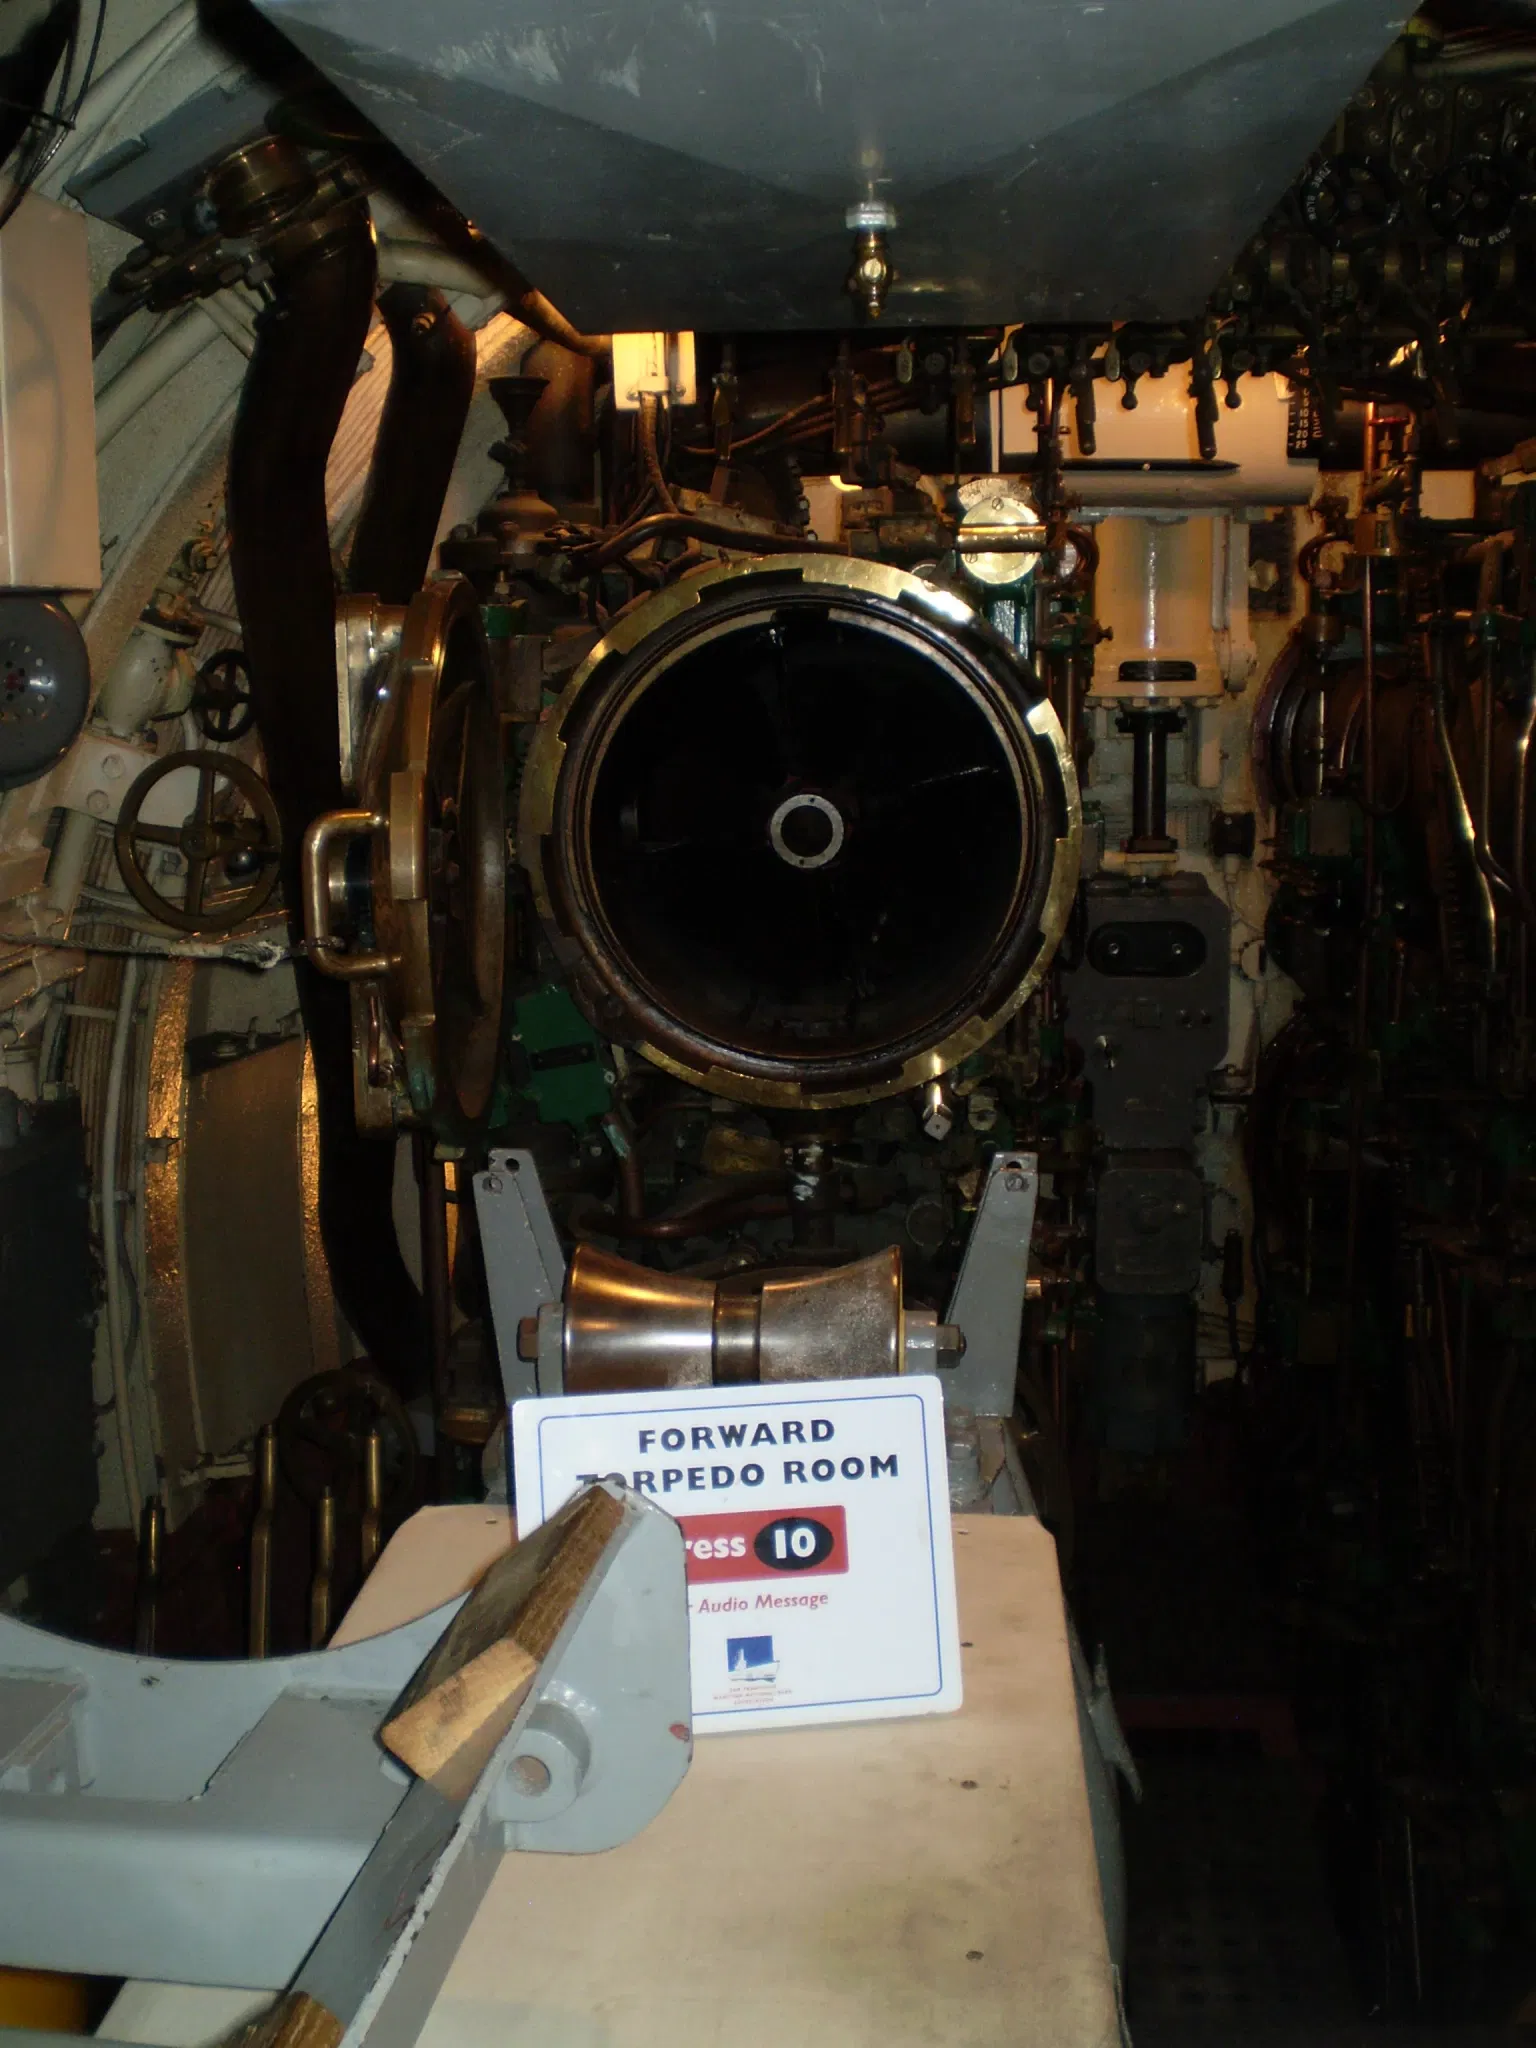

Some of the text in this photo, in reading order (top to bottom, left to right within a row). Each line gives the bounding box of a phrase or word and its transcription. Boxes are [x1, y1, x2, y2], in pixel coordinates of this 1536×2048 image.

[1295, 429, 1309, 439] 20
[1299, 418, 1309, 428] 15
[1295, 439, 1308, 449] 25
[638, 1419, 835, 1454] FORWARD
[783, 1454, 899, 1485] ROOM
[685, 1527, 817, 1560] ess 10
[698, 1592, 829, 1614] Audio Message
